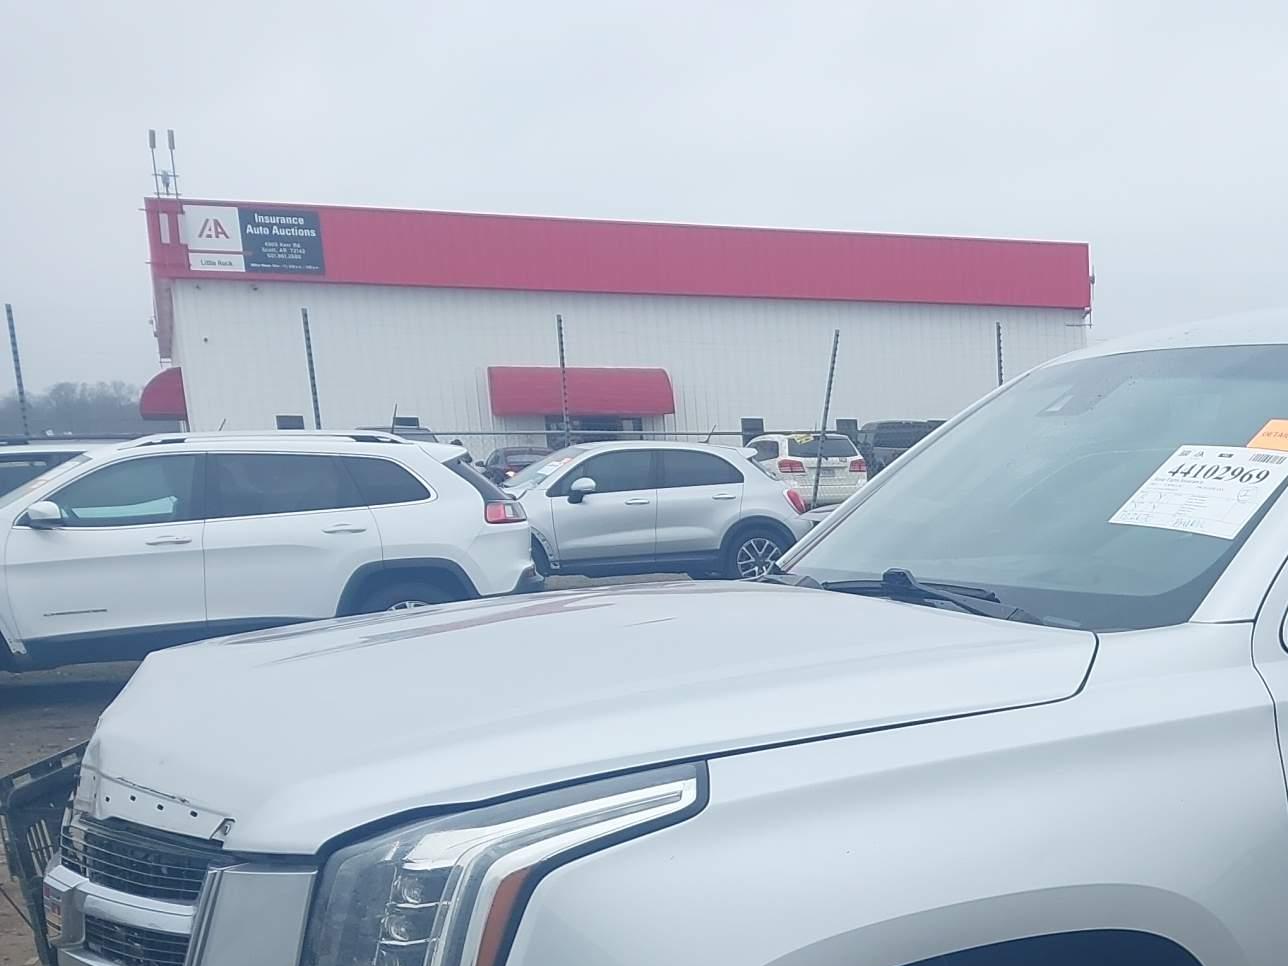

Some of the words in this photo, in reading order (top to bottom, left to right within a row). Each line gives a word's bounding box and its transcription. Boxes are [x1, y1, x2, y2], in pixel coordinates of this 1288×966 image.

[254, 212, 304, 225] Insurance
[246, 224, 270, 235] Auto
[272, 225, 317, 237] Auctions
[1168, 463, 1270, 485] 44102969
